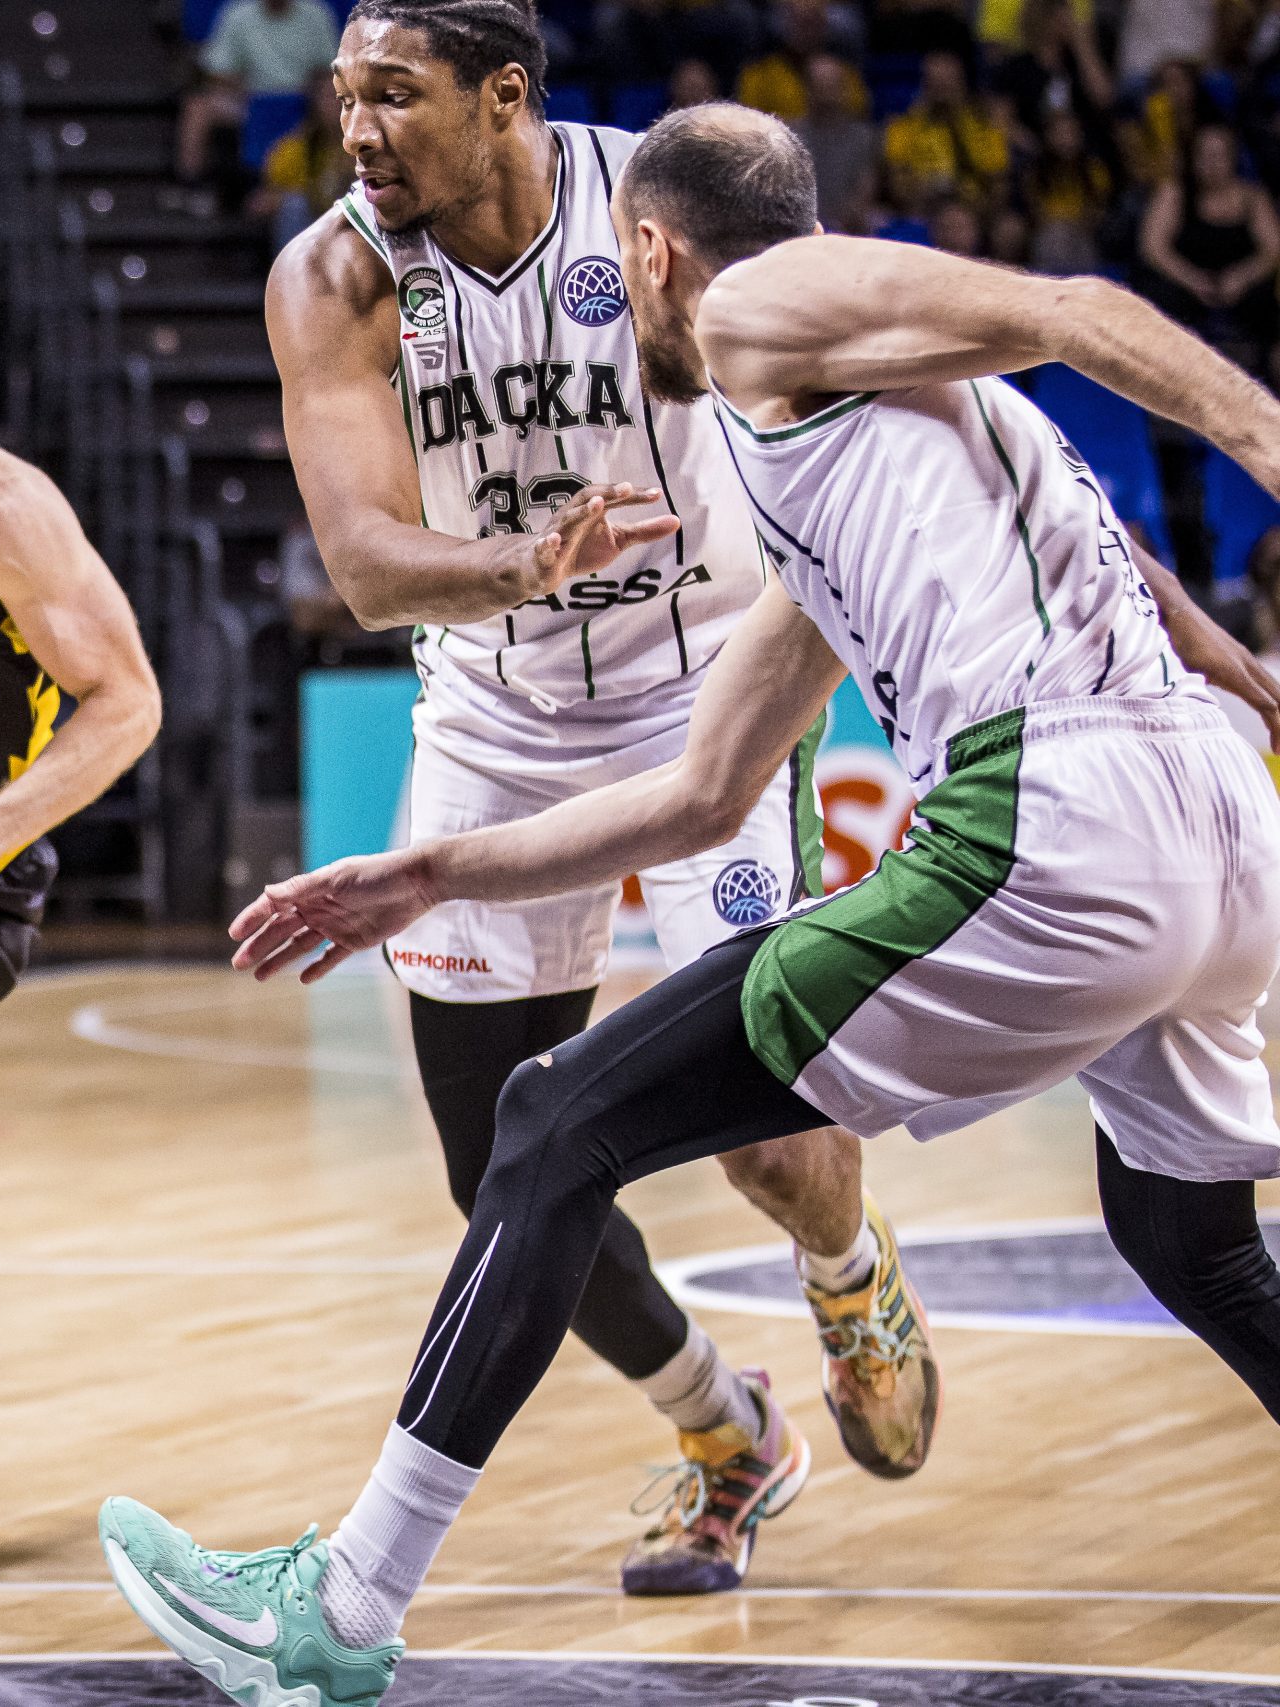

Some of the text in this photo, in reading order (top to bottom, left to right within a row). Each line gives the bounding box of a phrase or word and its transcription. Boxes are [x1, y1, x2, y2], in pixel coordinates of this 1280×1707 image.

[416, 327, 448, 338] LASS
[418, 360, 637, 453] DAÇKA
[511, 564, 713, 612] ASSA
[393, 949, 493, 973] MEMORIAL
